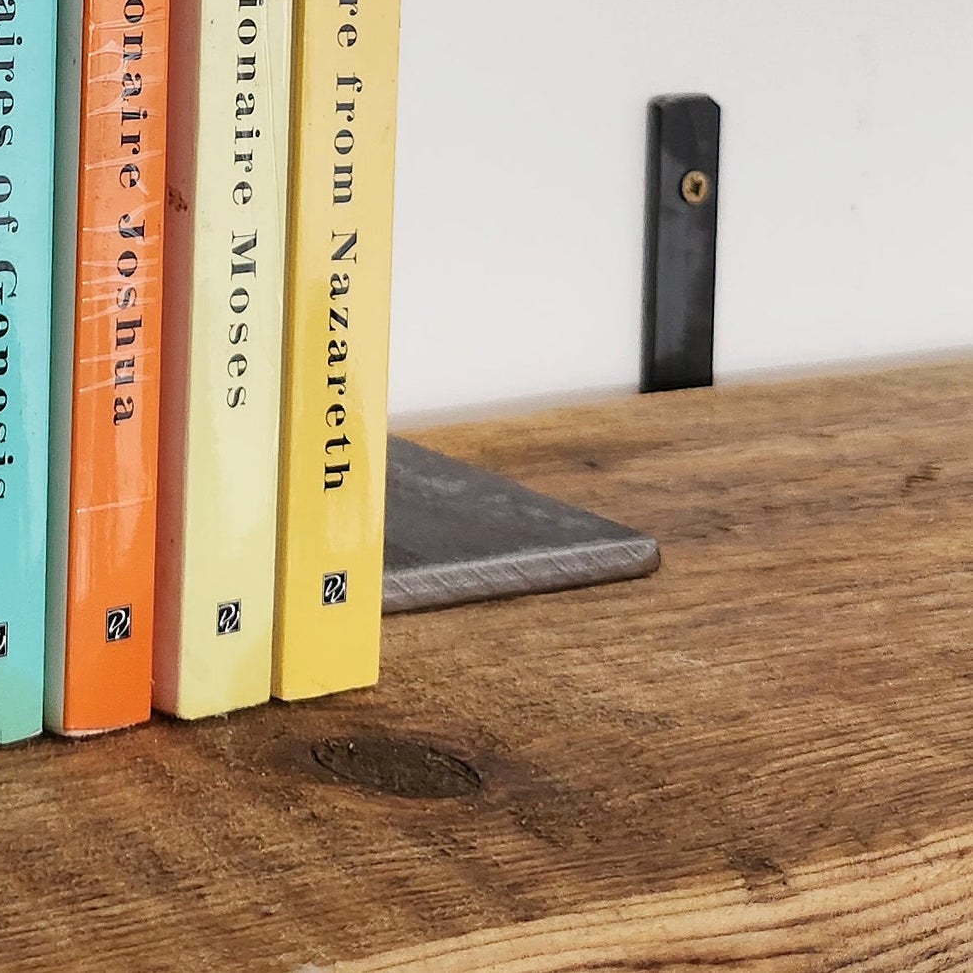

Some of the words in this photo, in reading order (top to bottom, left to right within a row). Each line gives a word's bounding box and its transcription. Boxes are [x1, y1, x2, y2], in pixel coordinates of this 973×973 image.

[332, 72, 363, 205] from
[113, 213, 147, 426] Joshua
[226, 229, 258, 409] Moses
[323, 228, 358, 493] Nazareth
